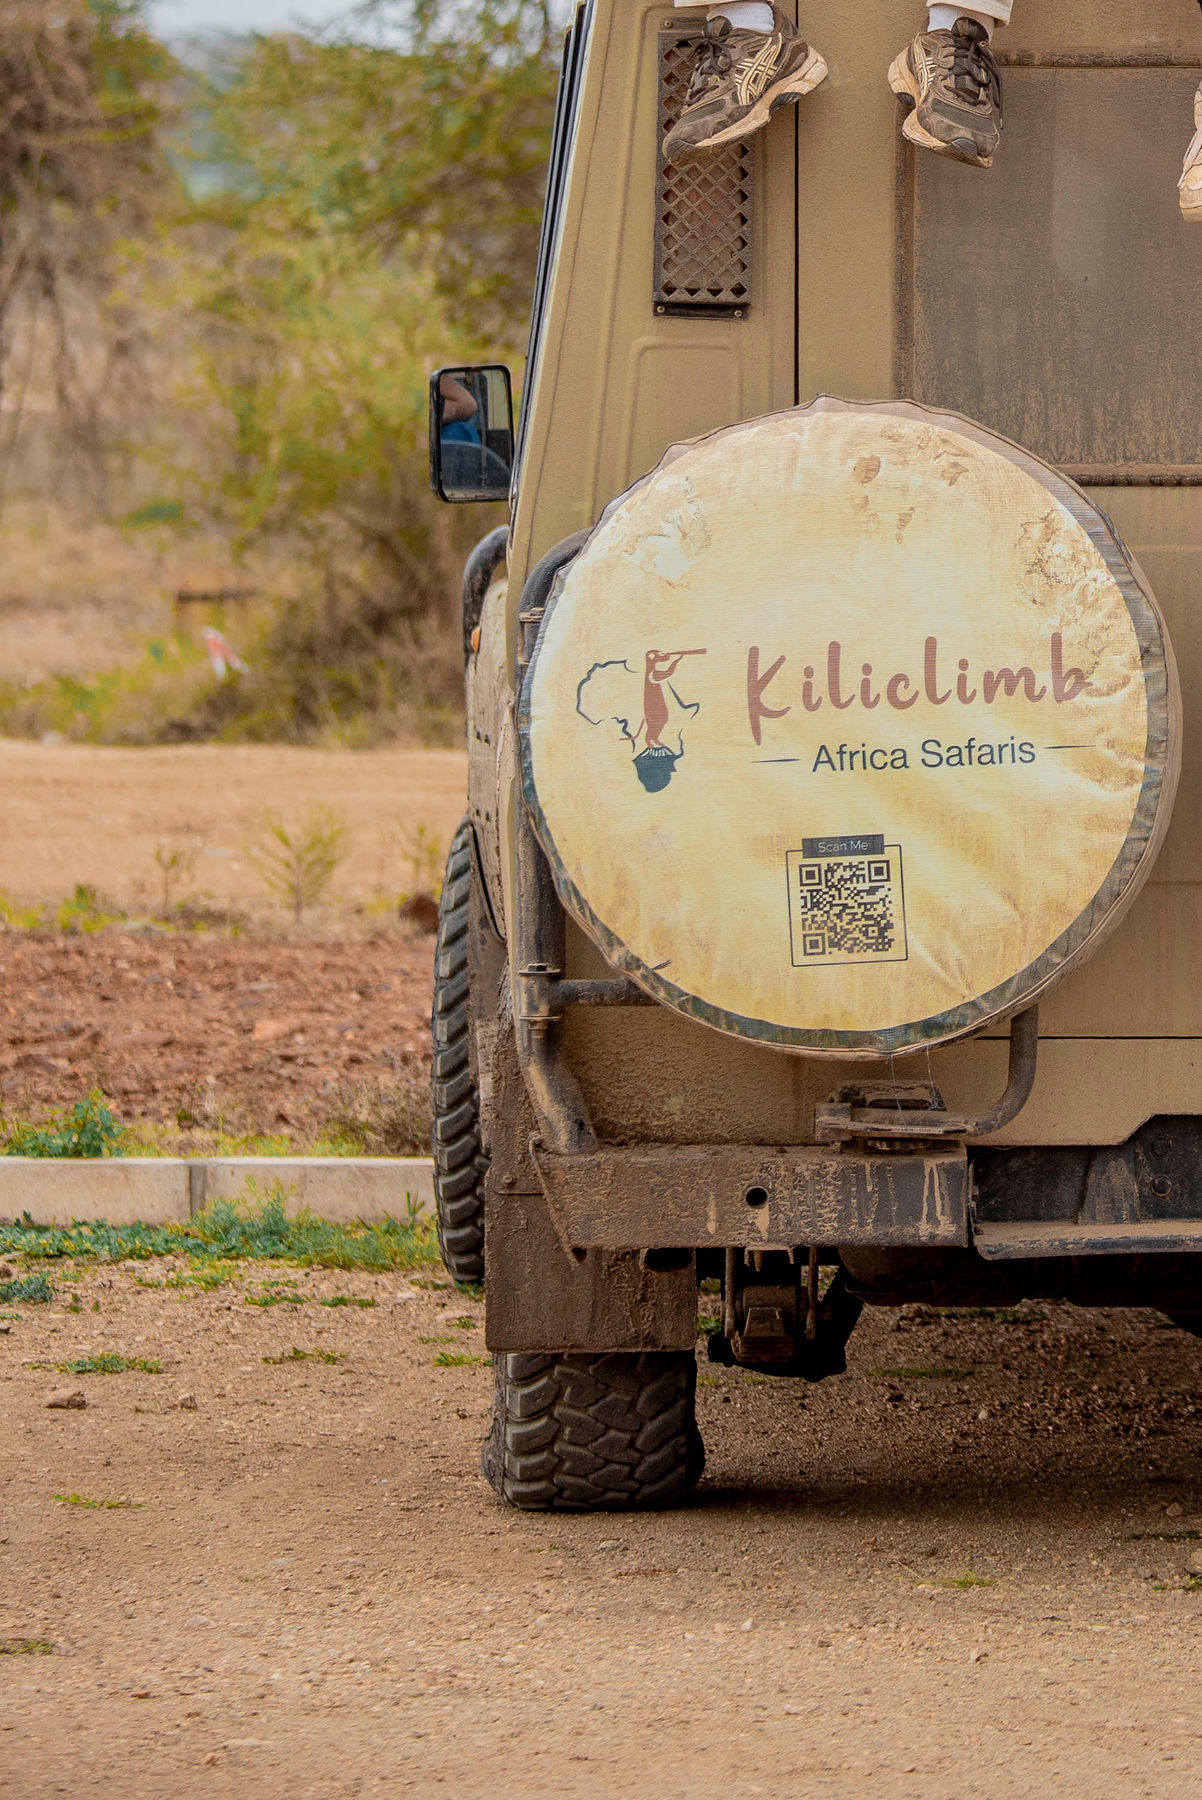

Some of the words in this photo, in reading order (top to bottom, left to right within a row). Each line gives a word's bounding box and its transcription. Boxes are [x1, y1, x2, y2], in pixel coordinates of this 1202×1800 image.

[747, 632, 1094, 746] Kiliclimb
[812, 743, 909, 773] Africa
[921, 736, 1036, 768] Safaris
[817, 841, 847, 853] Scan
[850, 840, 869, 851] Me
